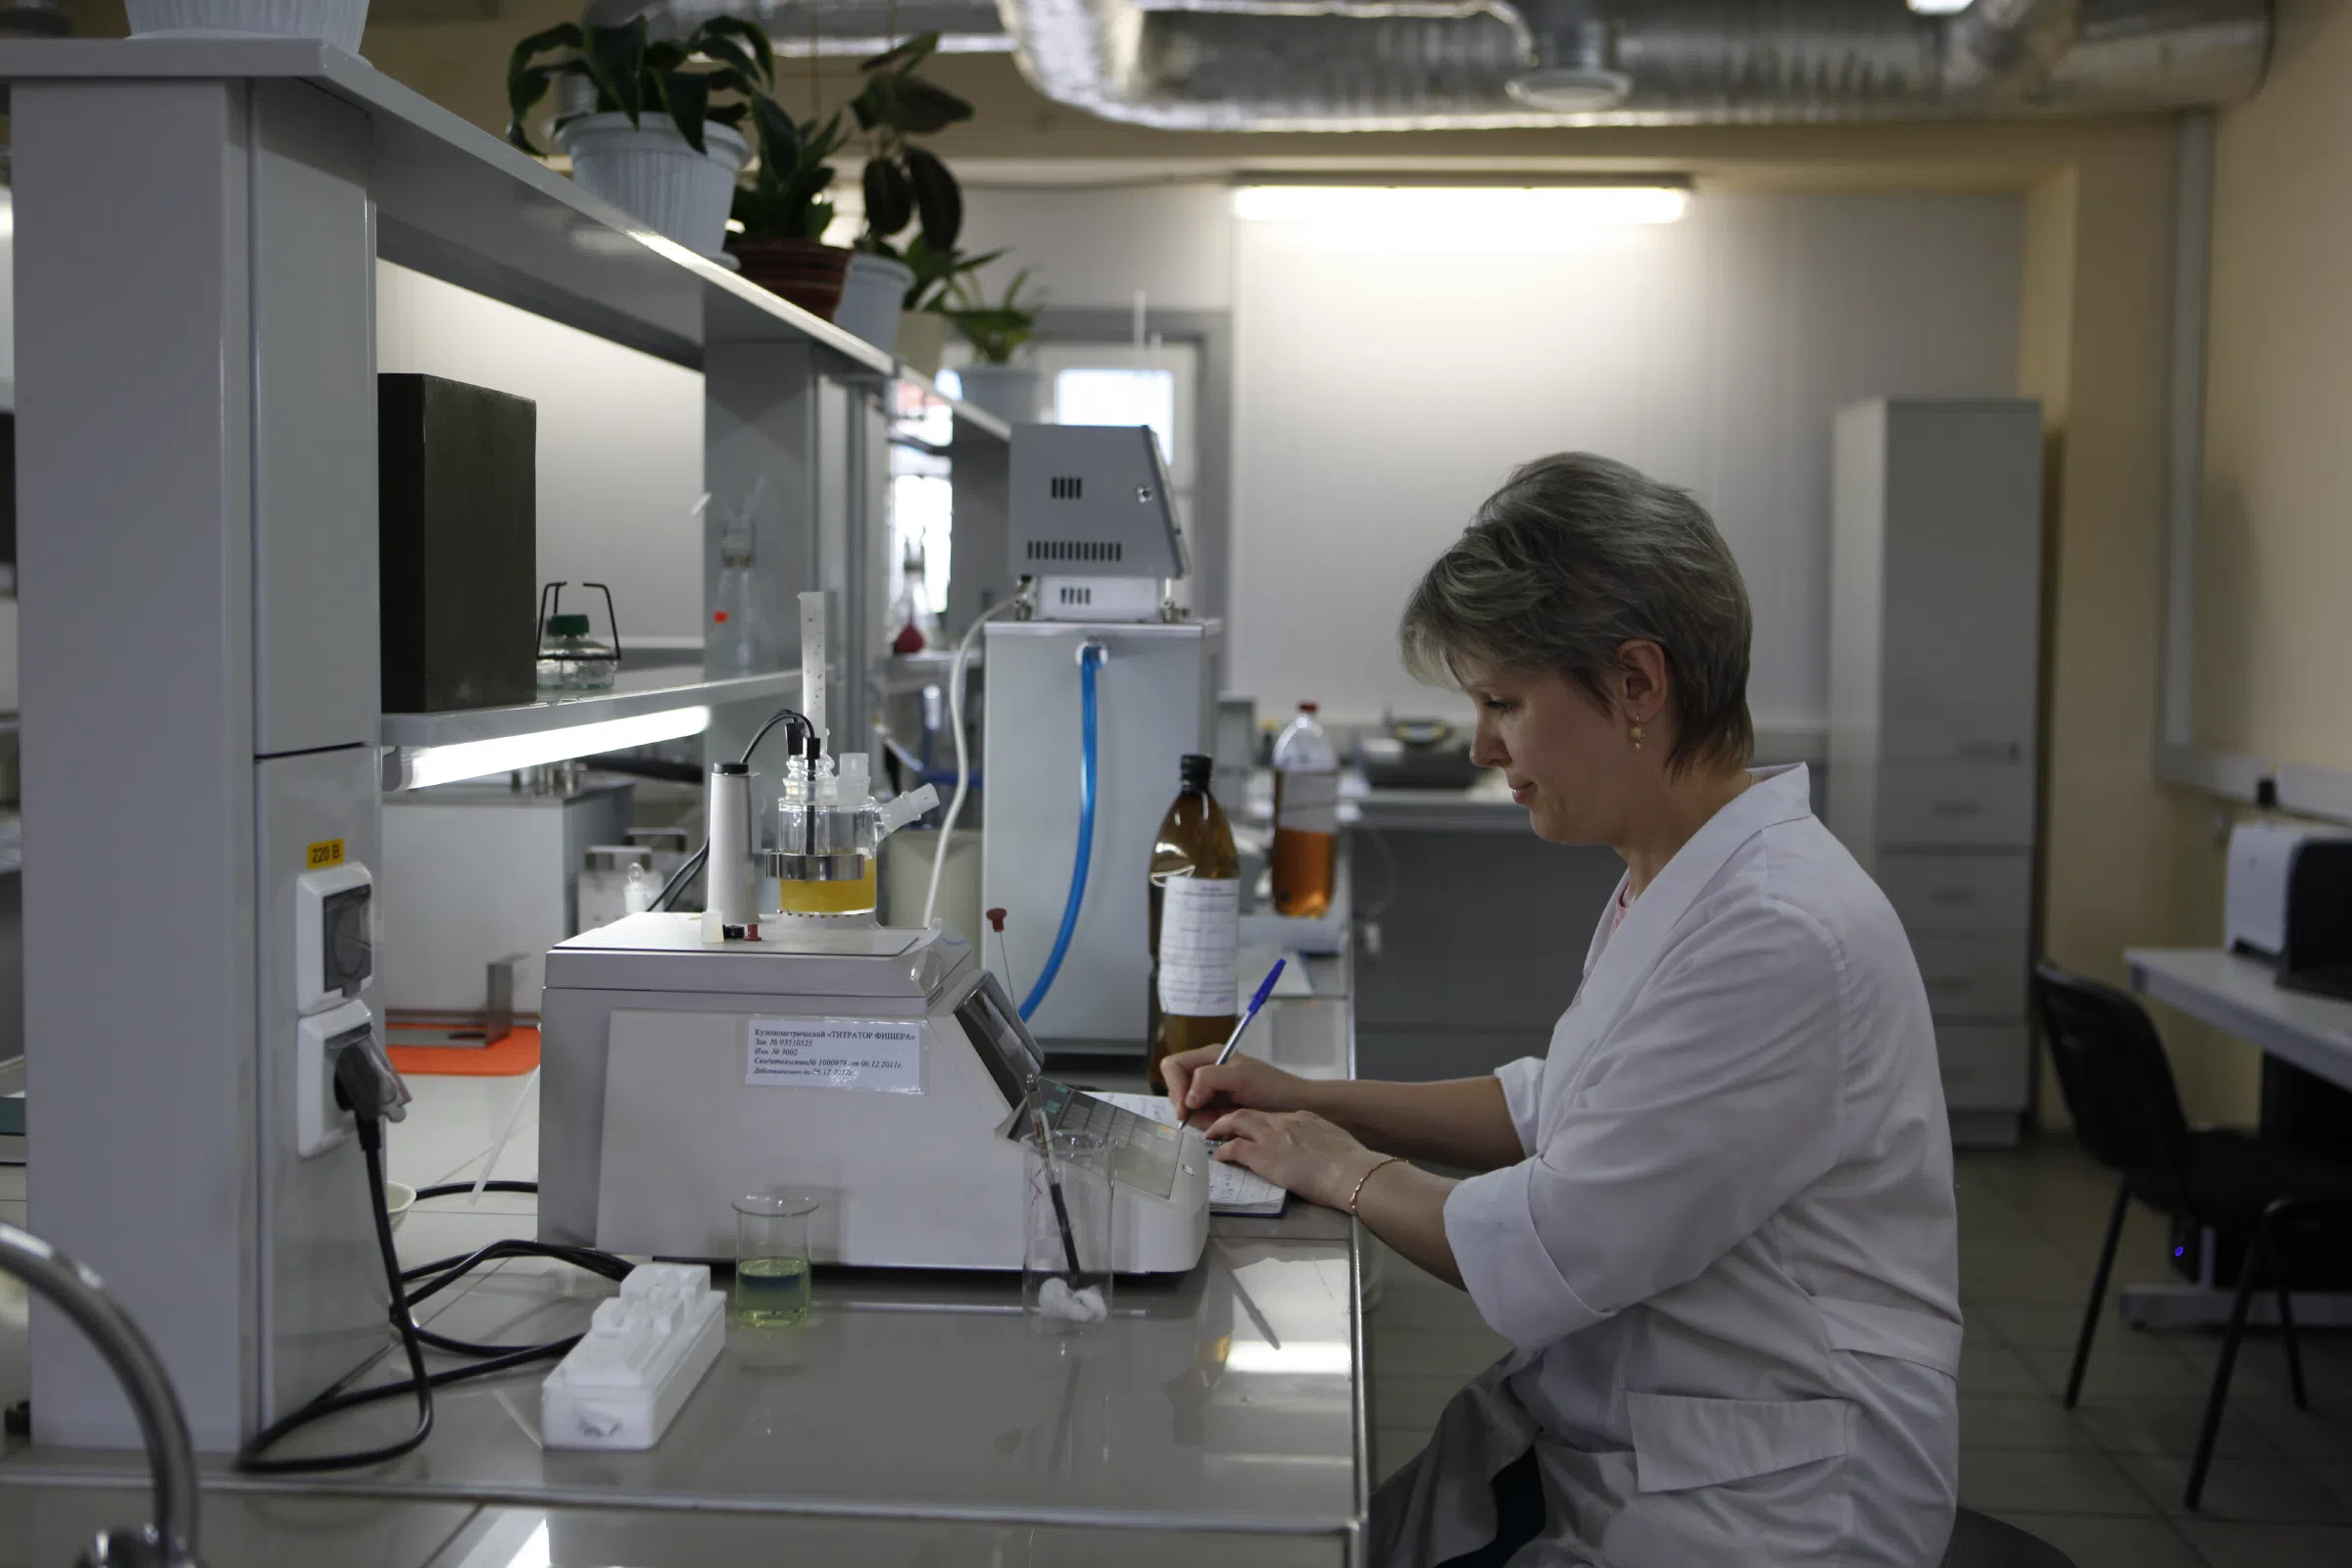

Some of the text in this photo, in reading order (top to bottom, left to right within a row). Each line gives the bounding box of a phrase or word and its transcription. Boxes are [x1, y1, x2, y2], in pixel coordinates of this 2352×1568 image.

[312, 846, 330, 863] 220
[755, 1029, 915, 1041] Кулонометрический «ТИТРАТОР ФИШЕРА»
